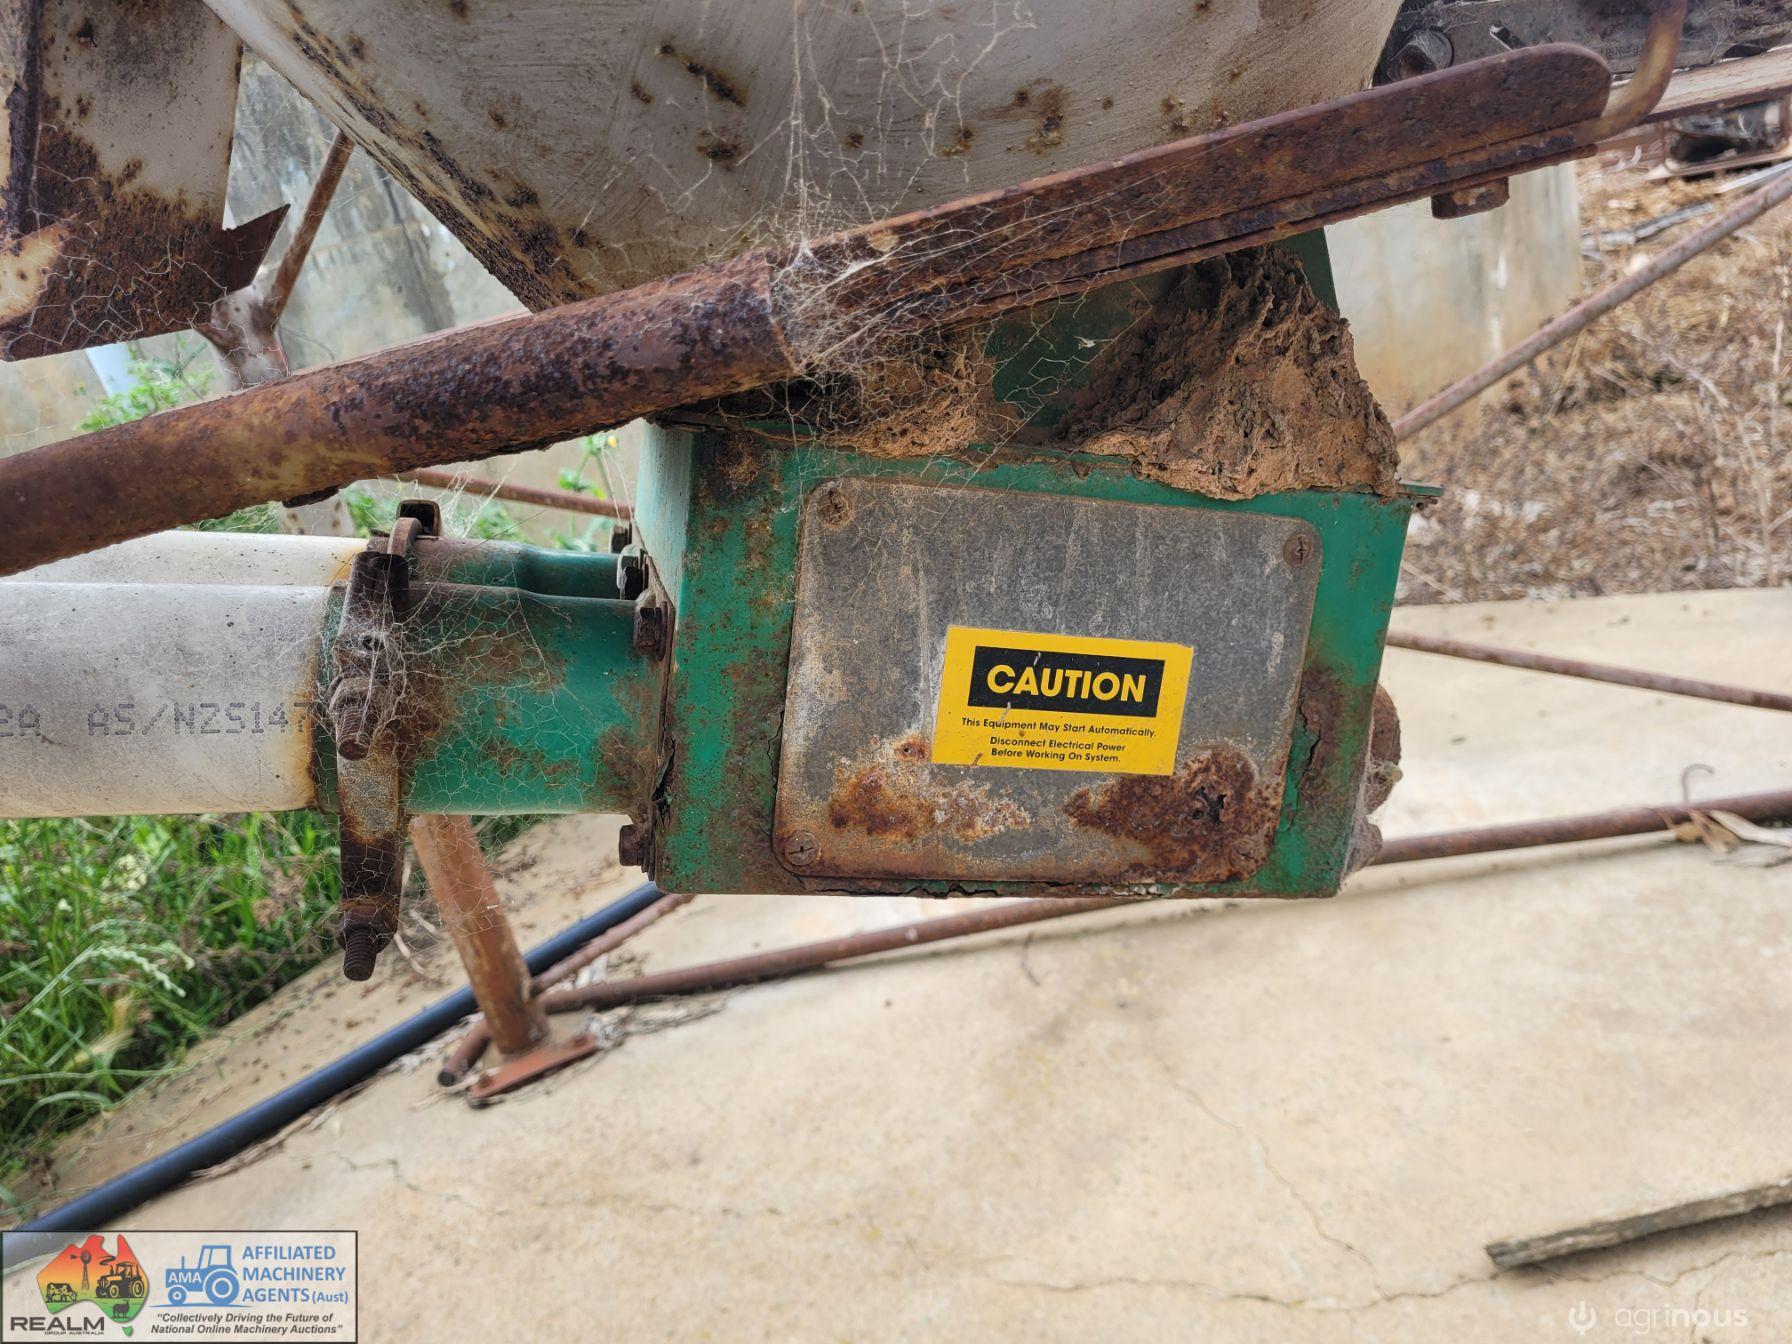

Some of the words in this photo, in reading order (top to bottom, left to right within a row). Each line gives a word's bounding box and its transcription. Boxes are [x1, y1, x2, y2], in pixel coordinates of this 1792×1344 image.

[987, 664, 1147, 703] CAUTION
[962, 717, 980, 727] This
[983, 718, 1037, 730] Equipment
[1039, 722, 1060, 733] May
[1063, 723, 1086, 733] Start
[1088, 725, 1157, 738] Automatically.
[990, 736, 1046, 747] Disconnect
[1049, 739, 1094, 750] Electrical
[1097, 742, 1126, 752] Power
[991, 748, 1023, 758] Before
[1026, 749, 1065, 761] Working
[1068, 752, 1082, 761] On
[1085, 753, 1121, 763] System.
